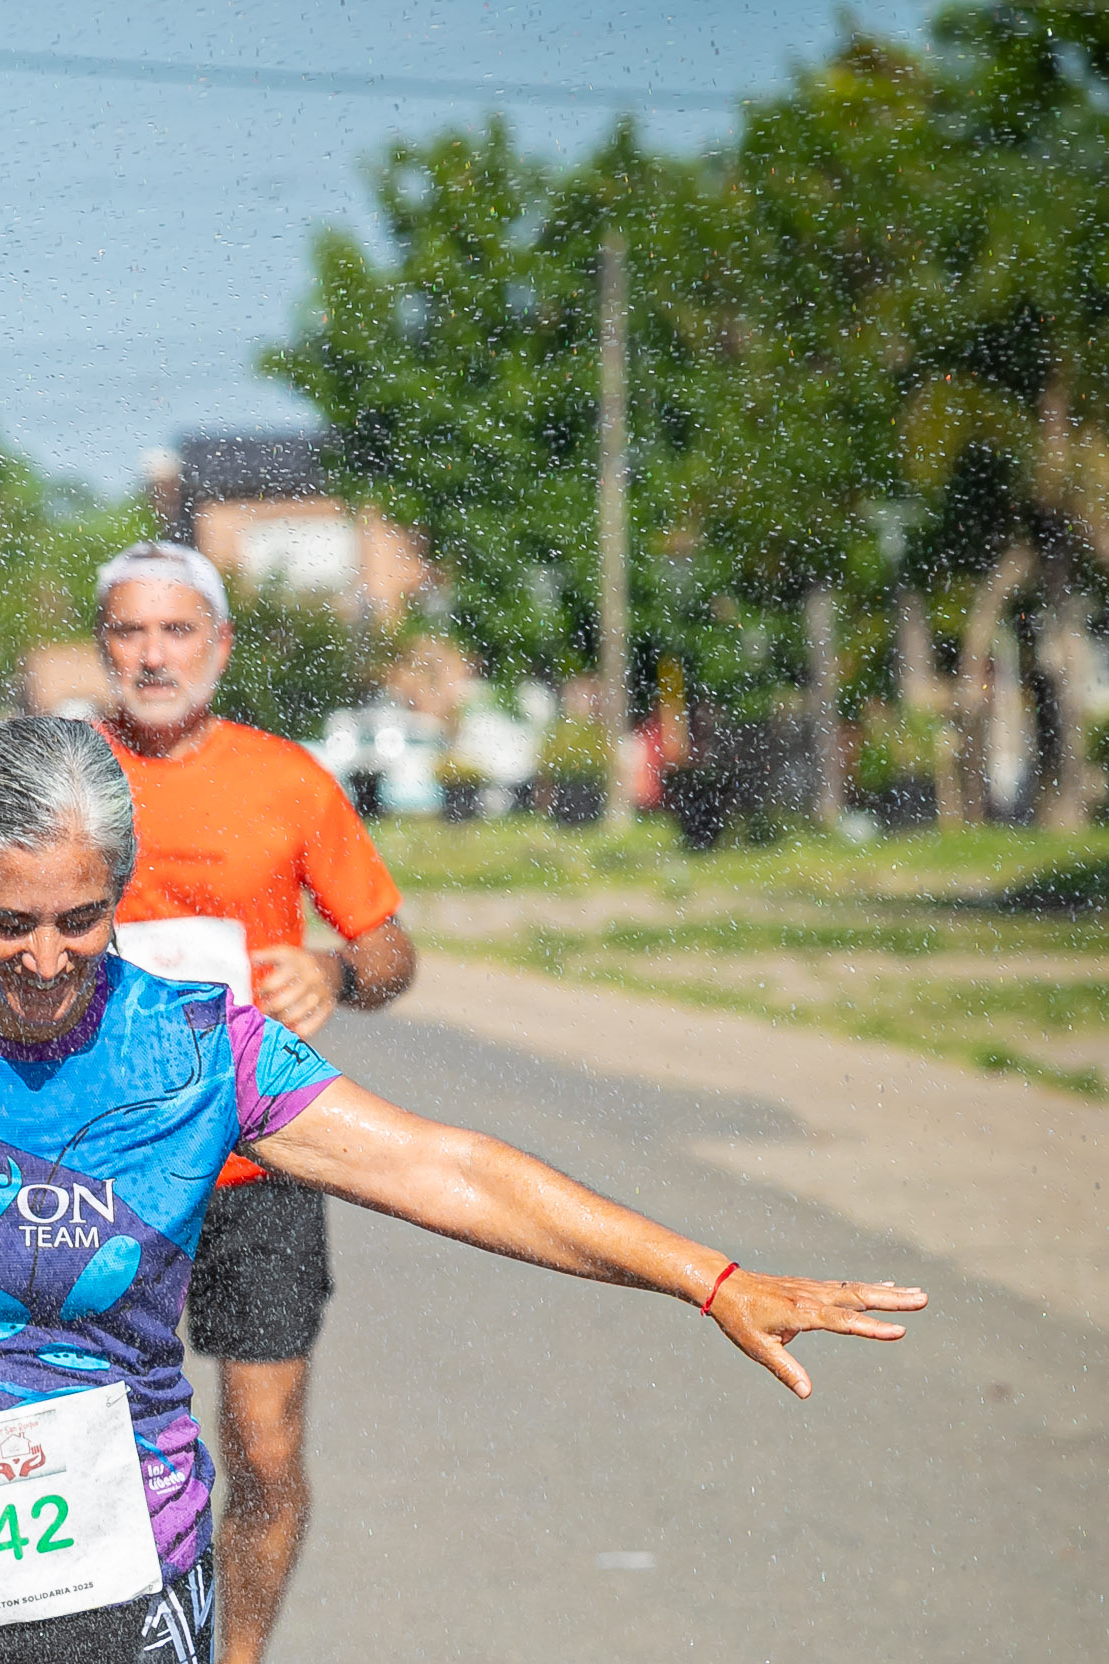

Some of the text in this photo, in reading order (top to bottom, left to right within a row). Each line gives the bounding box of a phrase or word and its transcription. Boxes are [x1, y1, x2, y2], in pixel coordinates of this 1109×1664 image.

[18, 1225, 100, 1249] TEAM
[22, 1587, 71, 1603] SOLIDARIA
[73, 1581, 94, 1592] 2025
